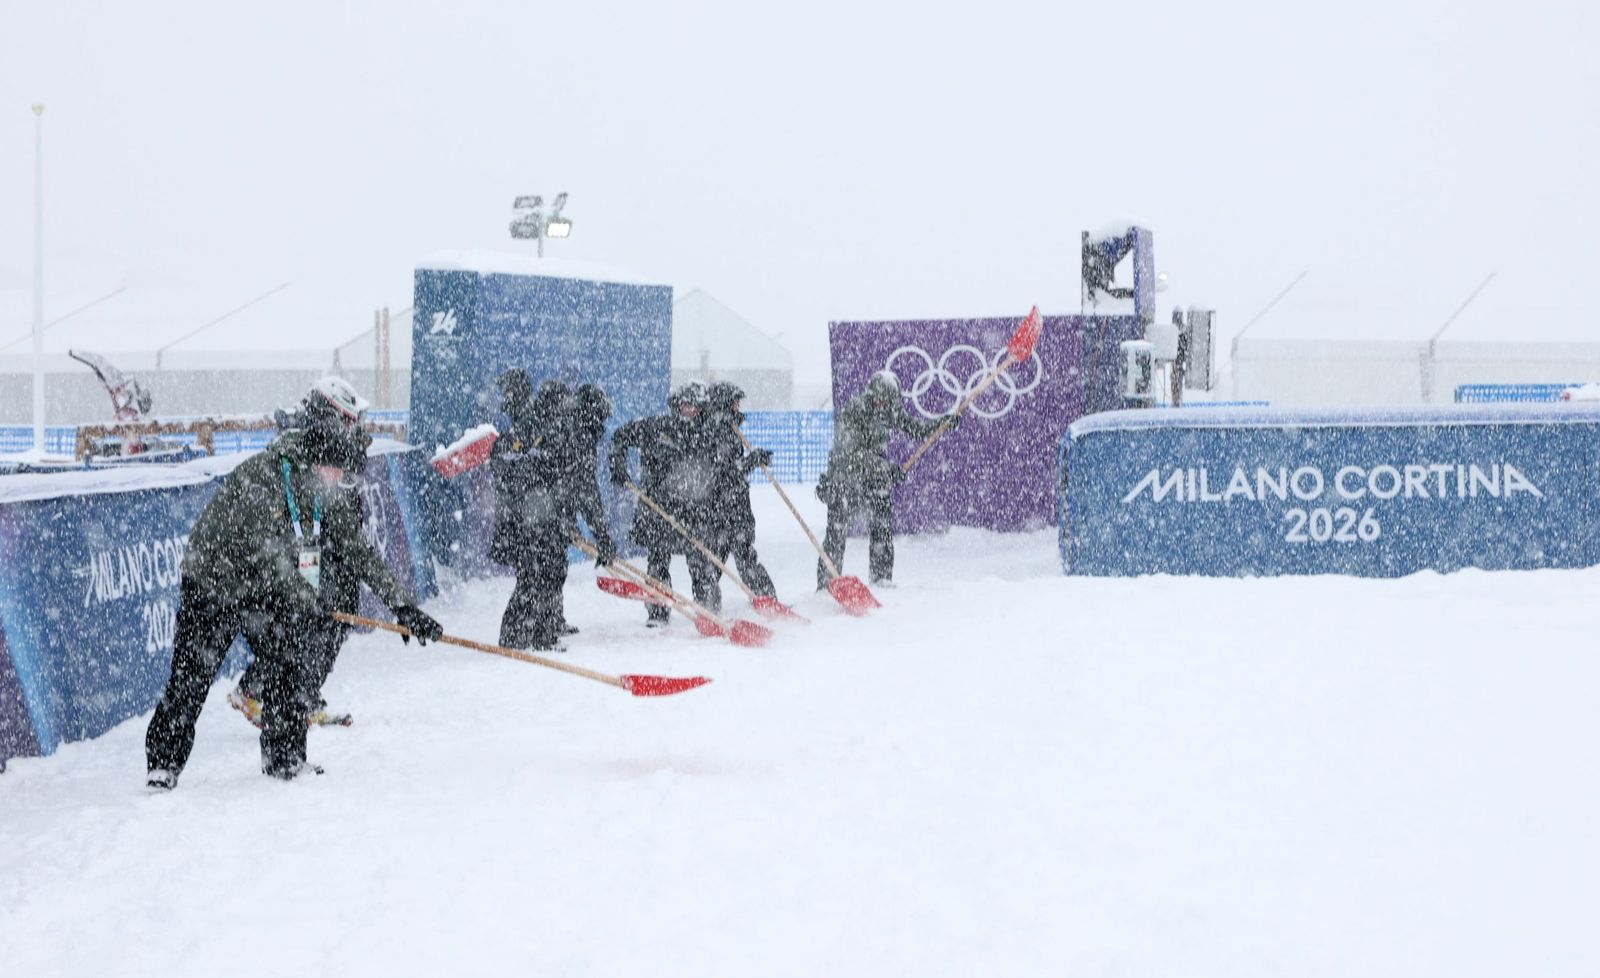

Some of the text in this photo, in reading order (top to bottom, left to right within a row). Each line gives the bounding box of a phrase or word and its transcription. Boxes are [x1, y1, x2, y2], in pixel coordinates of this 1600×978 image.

[1122, 465, 1543, 503] MILANO CORTINA
[1285, 507, 1382, 542] 2026
[84, 535, 189, 608] MILANO COR
